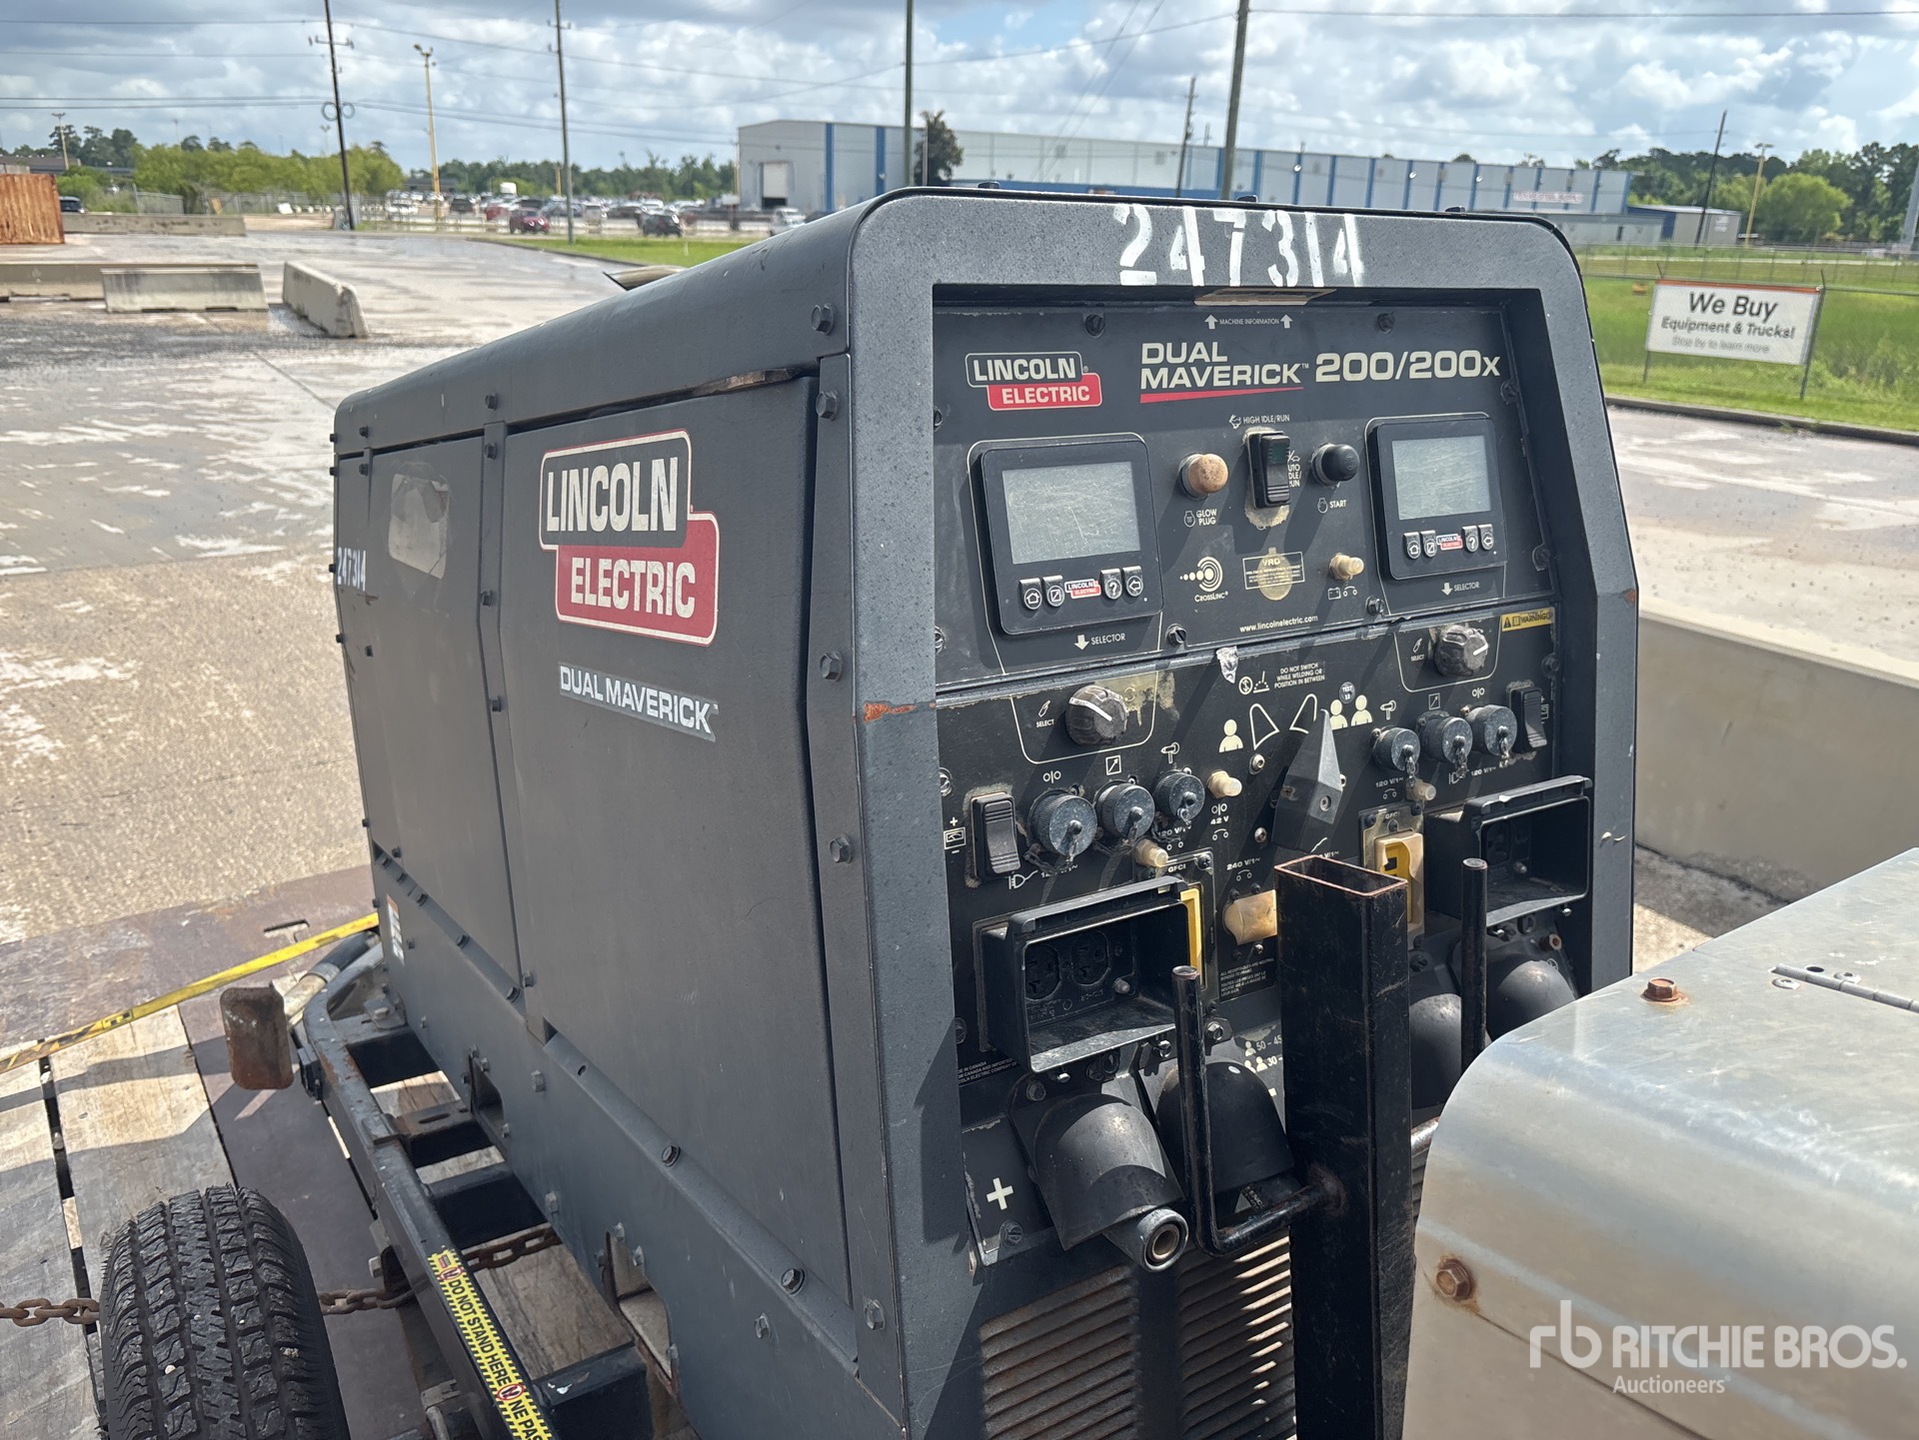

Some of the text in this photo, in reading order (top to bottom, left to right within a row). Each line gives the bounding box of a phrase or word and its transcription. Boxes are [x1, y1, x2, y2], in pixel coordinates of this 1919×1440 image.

[1113, 203, 1364, 287] 247314
[1689, 291, 1778, 323] We Buy
[1219, 318, 1280, 326] MACHINE INFORMATION
[1661, 315, 1796, 339] Equipment & Trucks!
[1141, 341, 1228, 365] DUAL
[973, 358, 1077, 382] LINCOLN
[1002, 385, 1090, 405] ELECTRIC
[1243, 414, 1290, 424] HIGH IDLE/RUN
[1287, 464, 1301, 472] UTO
[546, 456, 679, 532] LINCOLN
[1330, 499, 1347, 509] START
[1196, 508, 1217, 519] GLOW
[1199, 517, 1217, 526] PLUG
[571, 557, 696, 619] ELECTRIC
[1067, 580, 1093, 591] LINCOLN
[1453, 581, 1480, 592] SELECTOR
[1239, 615, 1319, 633] www.lincolnelectric.com
[1091, 632, 1126, 646] SELECTOR
[1280, 667, 1289, 675] DO
[560, 664, 604, 702] DUAL
[1036, 718, 1055, 728] SELECT
[1167, 864, 1187, 873] GFCI
[1226, 859, 1243, 871] 240
[1256, 1040, 1267, 1051] 50
[1266, 1055, 1278, 1067] 30
[448, 1279, 513, 1390] DO NOT STAND HERE
[508, 1398, 530, 1419] NE
